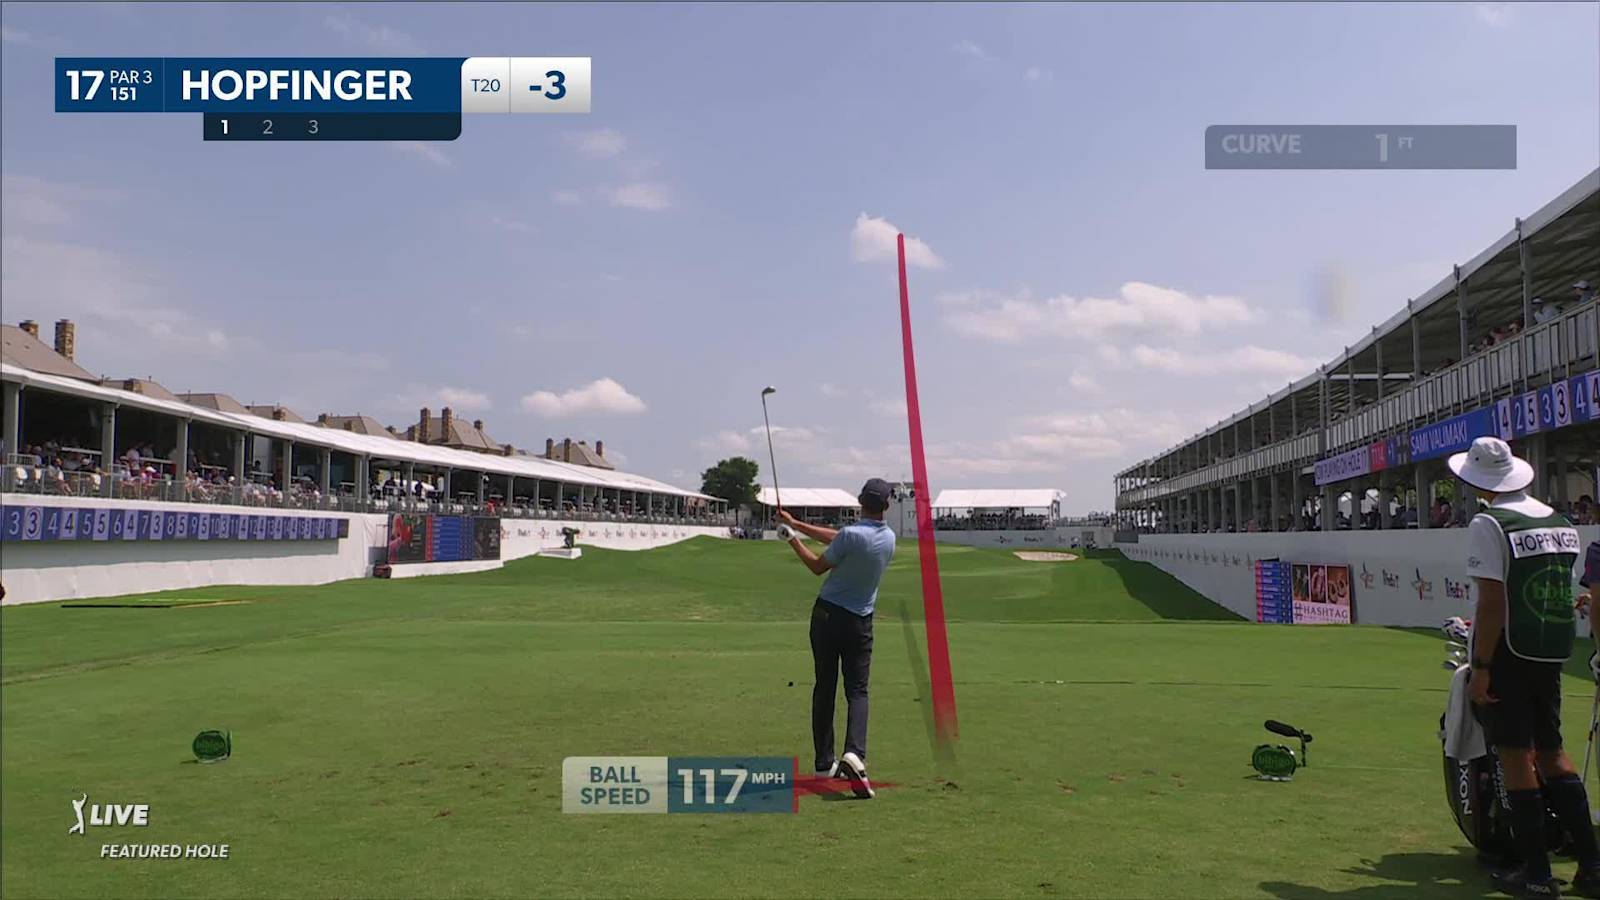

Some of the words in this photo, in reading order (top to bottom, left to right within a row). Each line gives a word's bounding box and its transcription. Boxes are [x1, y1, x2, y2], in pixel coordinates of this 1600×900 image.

[1410, 430, 1429, 455] SAMI
[1430, 420, 1467, 448] VALIMAKI
[1503, 405, 1509, 433] 4
[1514, 402, 1523, 430] 2
[1528, 398, 1535, 426] 5
[1543, 393, 1552, 424] 3
[1556, 388, 1566, 418] 3
[1576, 383, 1587, 414] 4
[9, 511, 20, 536] 3
[28, 511, 38, 535] 3
[48, 512, 59, 535] 4
[65, 512, 74, 535] 4
[82, 513, 92, 535] 5
[98, 513, 106, 535] 5
[113, 513, 122, 535] 6
[127, 512, 135, 534] 4
[141, 515, 150, 535] 7
[153, 514, 161, 535] 3
[167, 515, 175, 535] 8
[179, 515, 185, 534] 5
[191, 518, 198, 535] 9
[201, 517, 207, 535] 5
[222, 518, 228, 537] 3
[241, 518, 247, 536] 4
